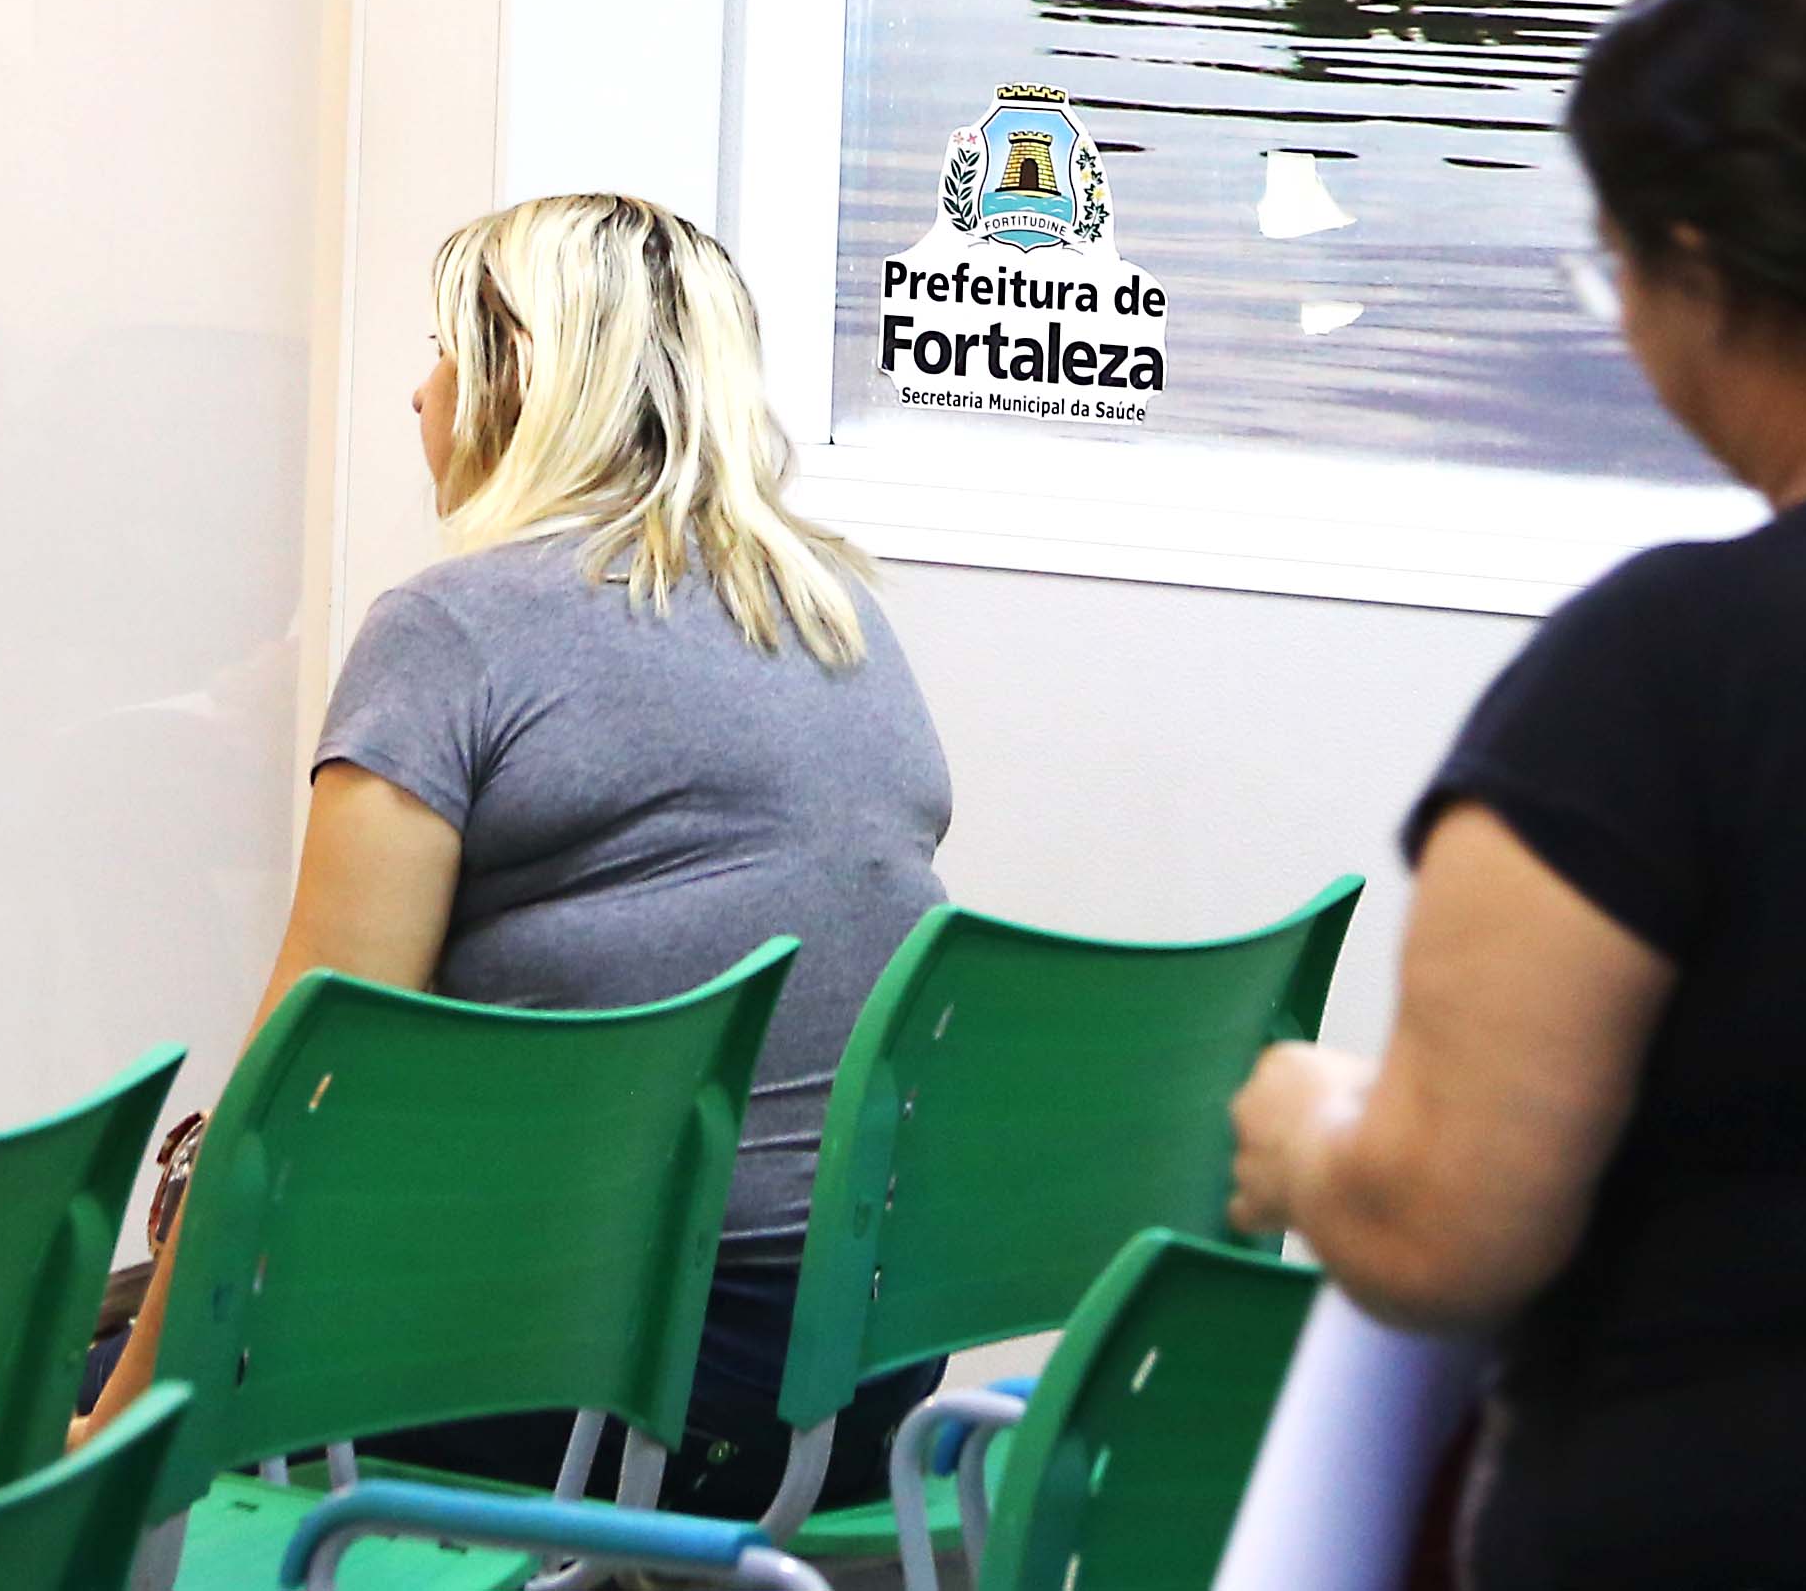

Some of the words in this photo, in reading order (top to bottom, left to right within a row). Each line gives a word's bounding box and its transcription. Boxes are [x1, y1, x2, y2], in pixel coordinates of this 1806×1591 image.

[984, 215, 1067, 237] FORTITUDINE
[883, 260, 1099, 313] Prefeitura
[1114, 275, 1166, 317] de
[881, 314, 1165, 391] Fortaleza
[901, 387, 983, 409] Secretaria
[989, 394, 1065, 417] Municipal
[1071, 399, 1090, 417] da
[1096, 401, 1146, 421] Saúde
